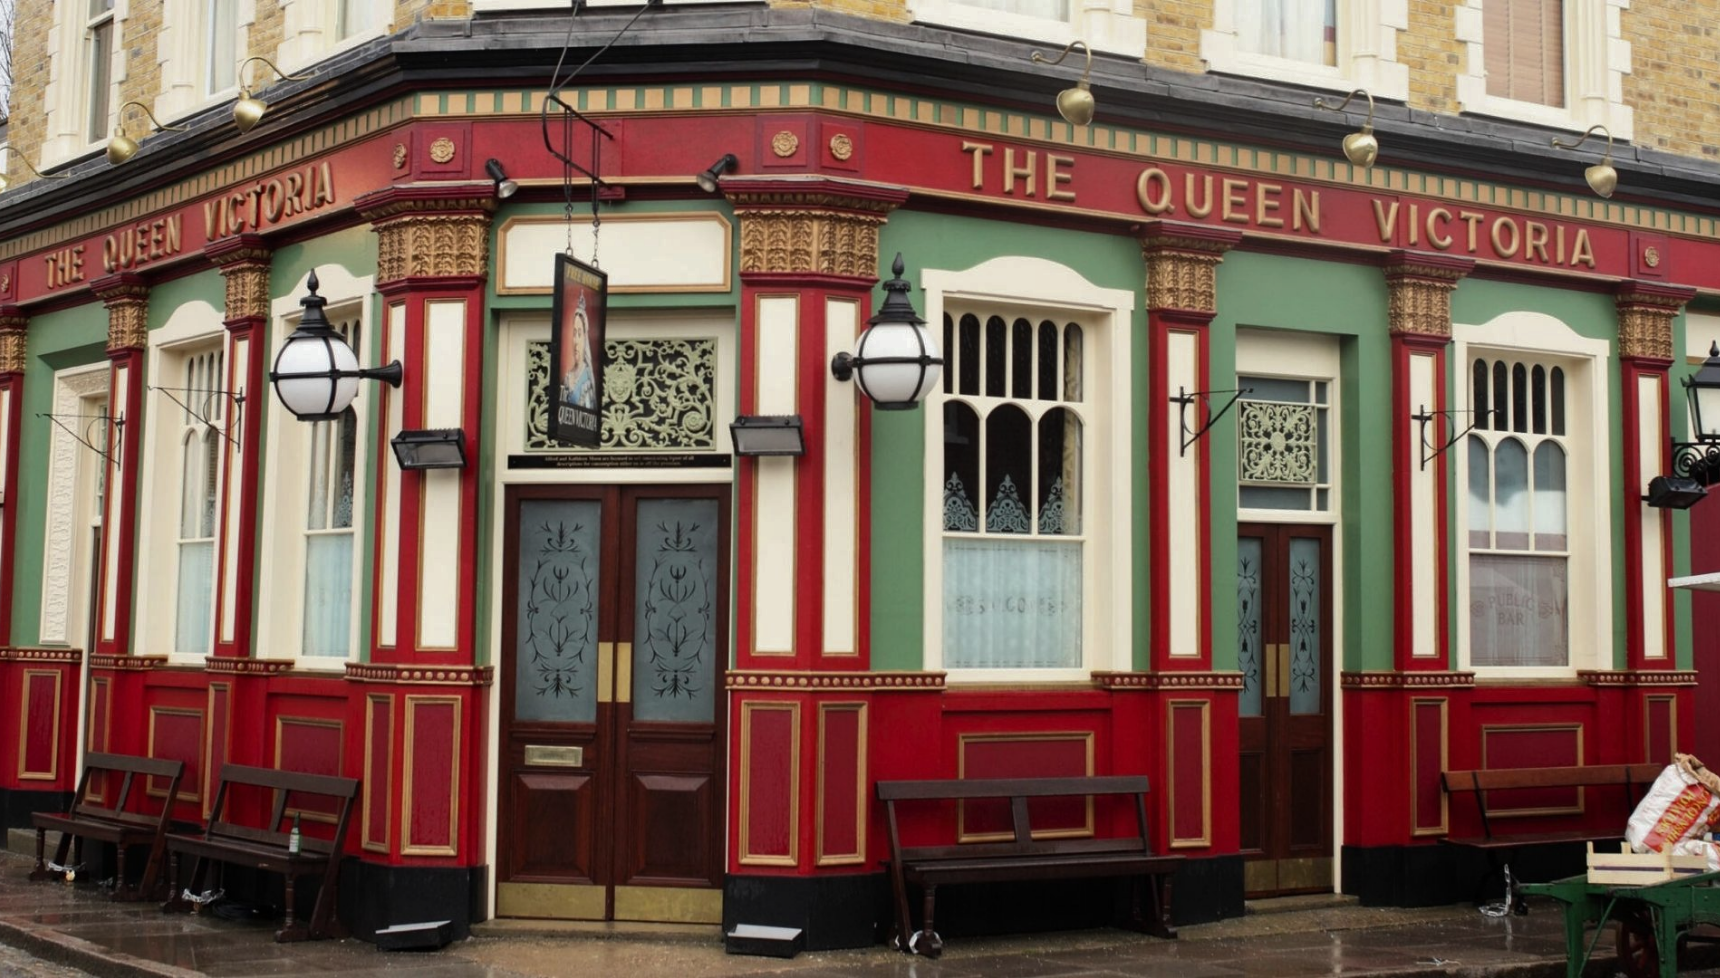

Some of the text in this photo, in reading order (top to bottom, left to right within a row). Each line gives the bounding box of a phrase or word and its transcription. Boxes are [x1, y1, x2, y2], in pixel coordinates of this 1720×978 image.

[961, 140, 1597, 269] THE QUEEN VICTORIA
[45, 161, 336, 289] THE QUEEN VICTORIA
[558, 405, 597, 432] QUEEN VICTORIA
[1488, 593, 1535, 611] PUBLIC
[1498, 612, 1525, 626] BAR
